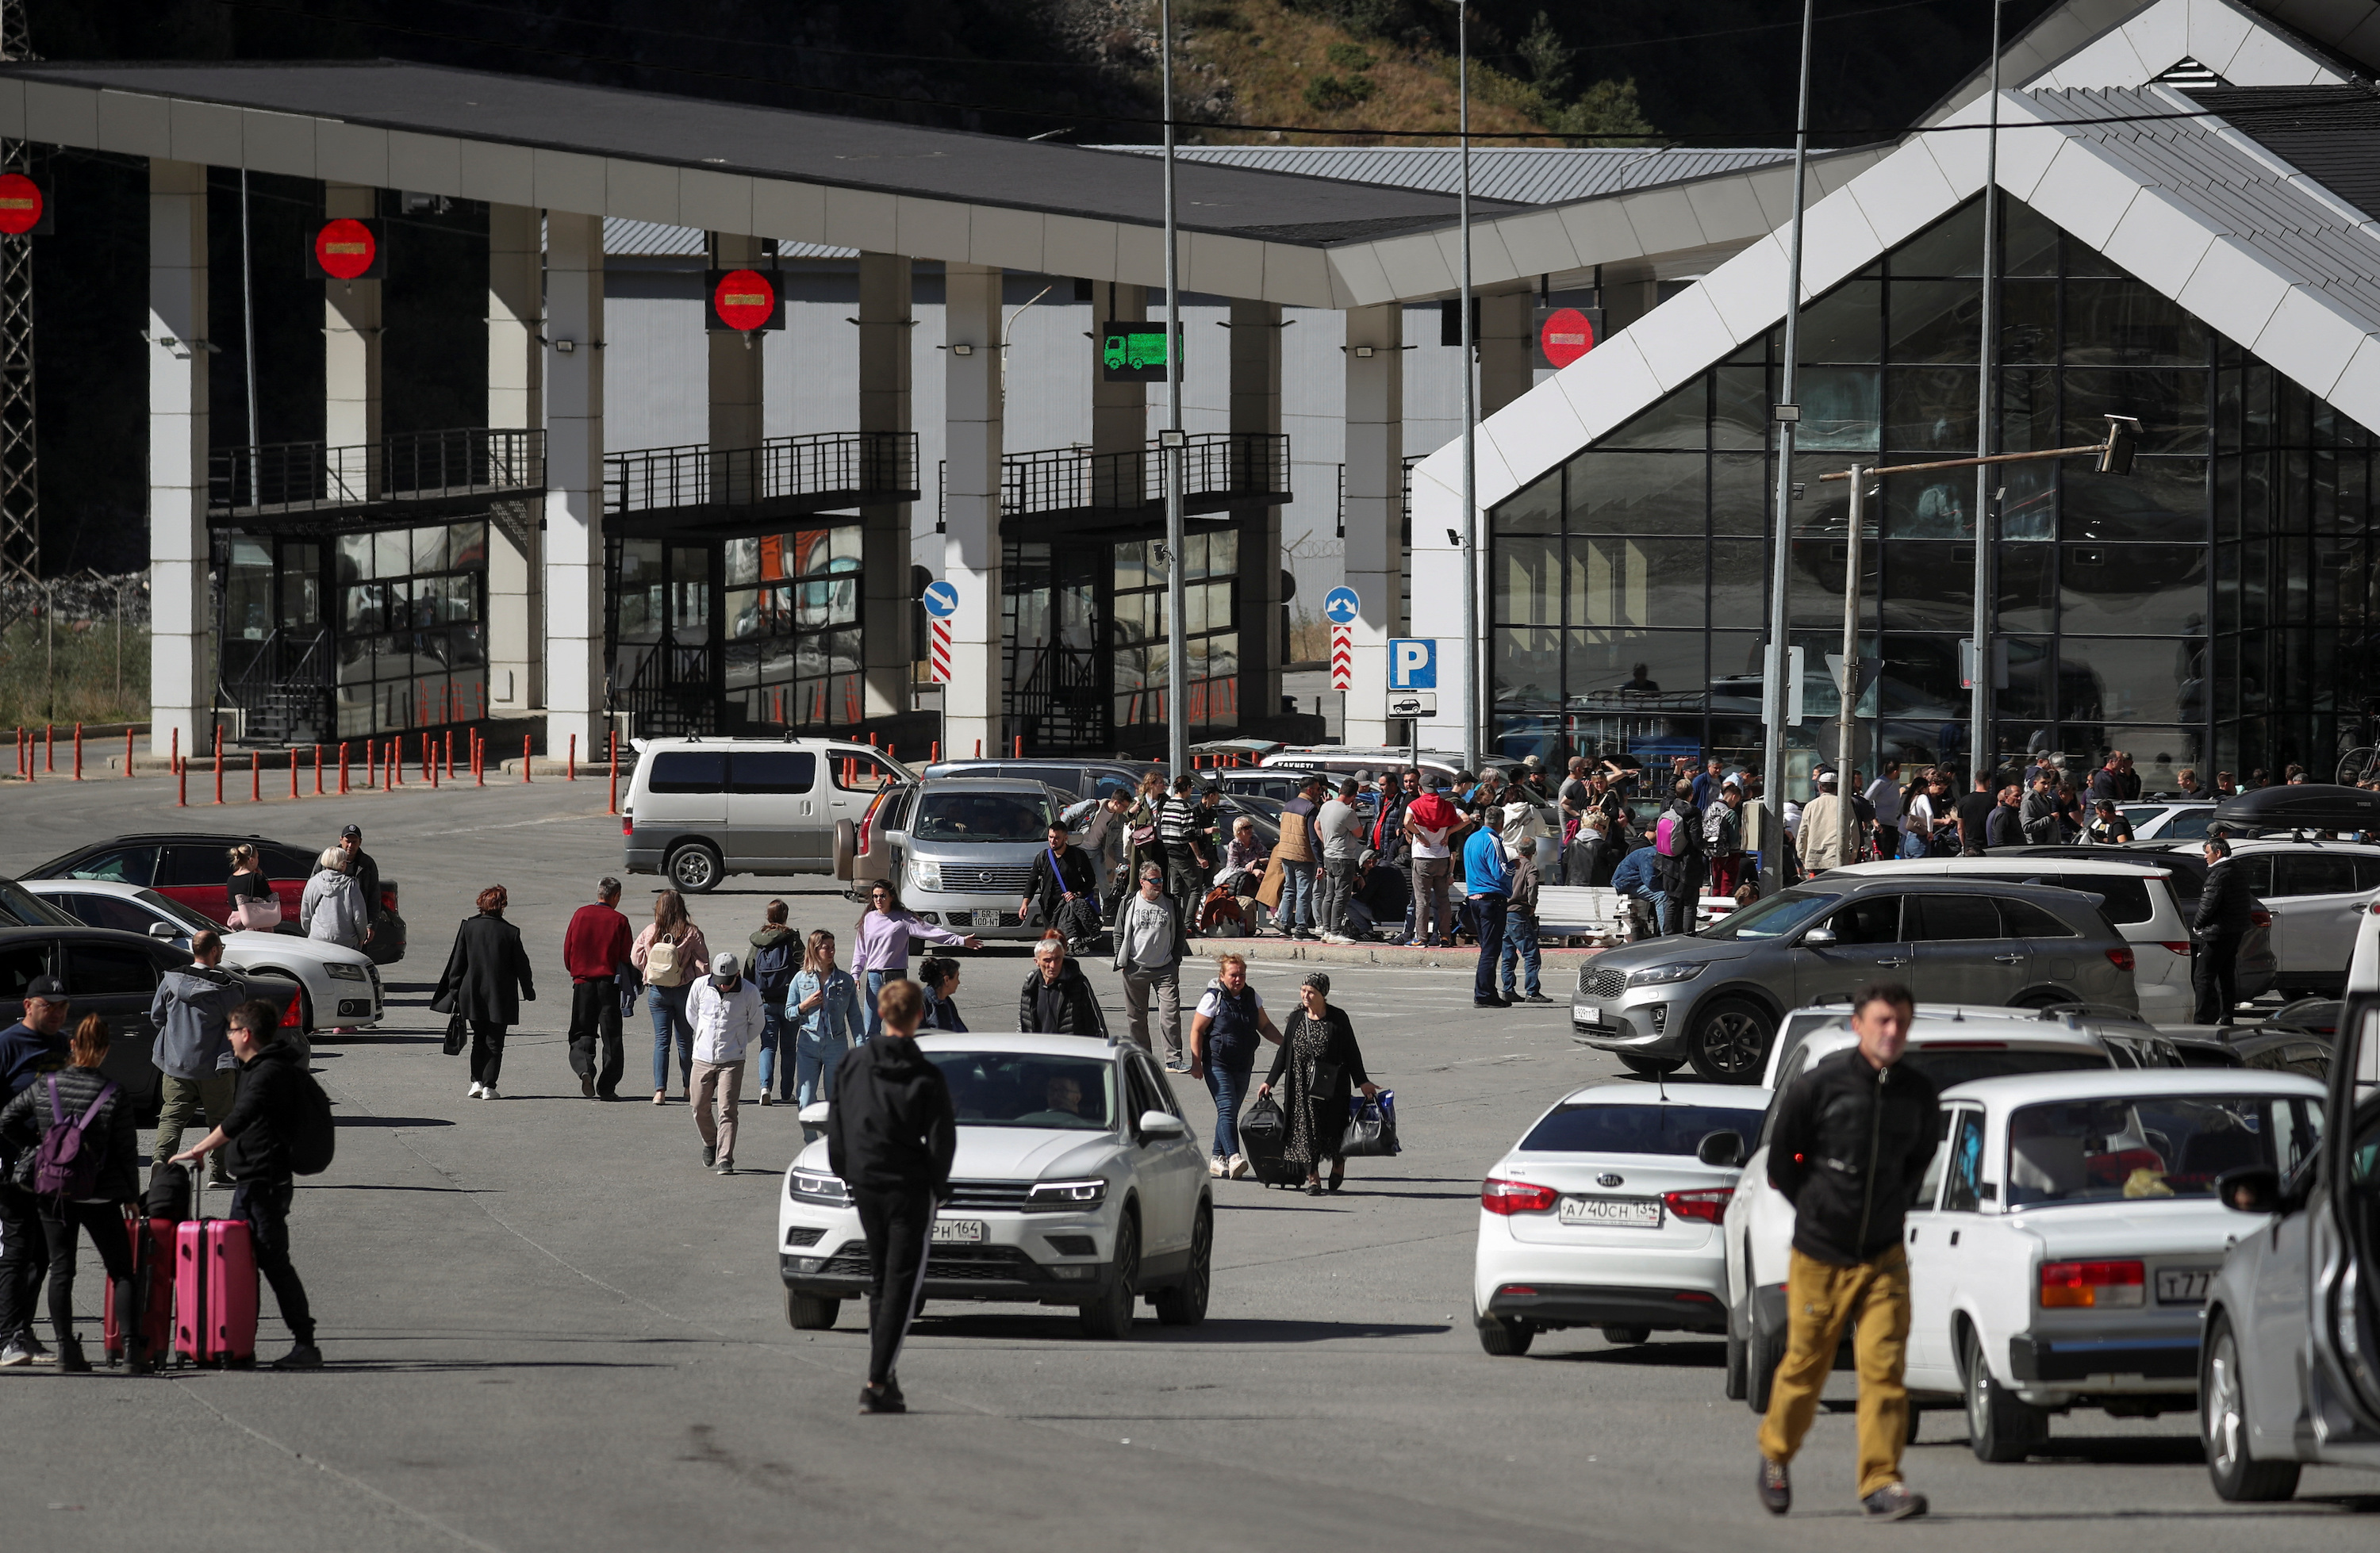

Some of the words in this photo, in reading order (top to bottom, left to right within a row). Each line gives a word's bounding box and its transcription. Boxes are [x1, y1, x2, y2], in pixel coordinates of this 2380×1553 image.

[1397, 642, 1429, 685] P
[1134, 909, 1168, 928] 1975
[1600, 1176, 1619, 1185] KIA
[954, 1222, 977, 1234] 164
